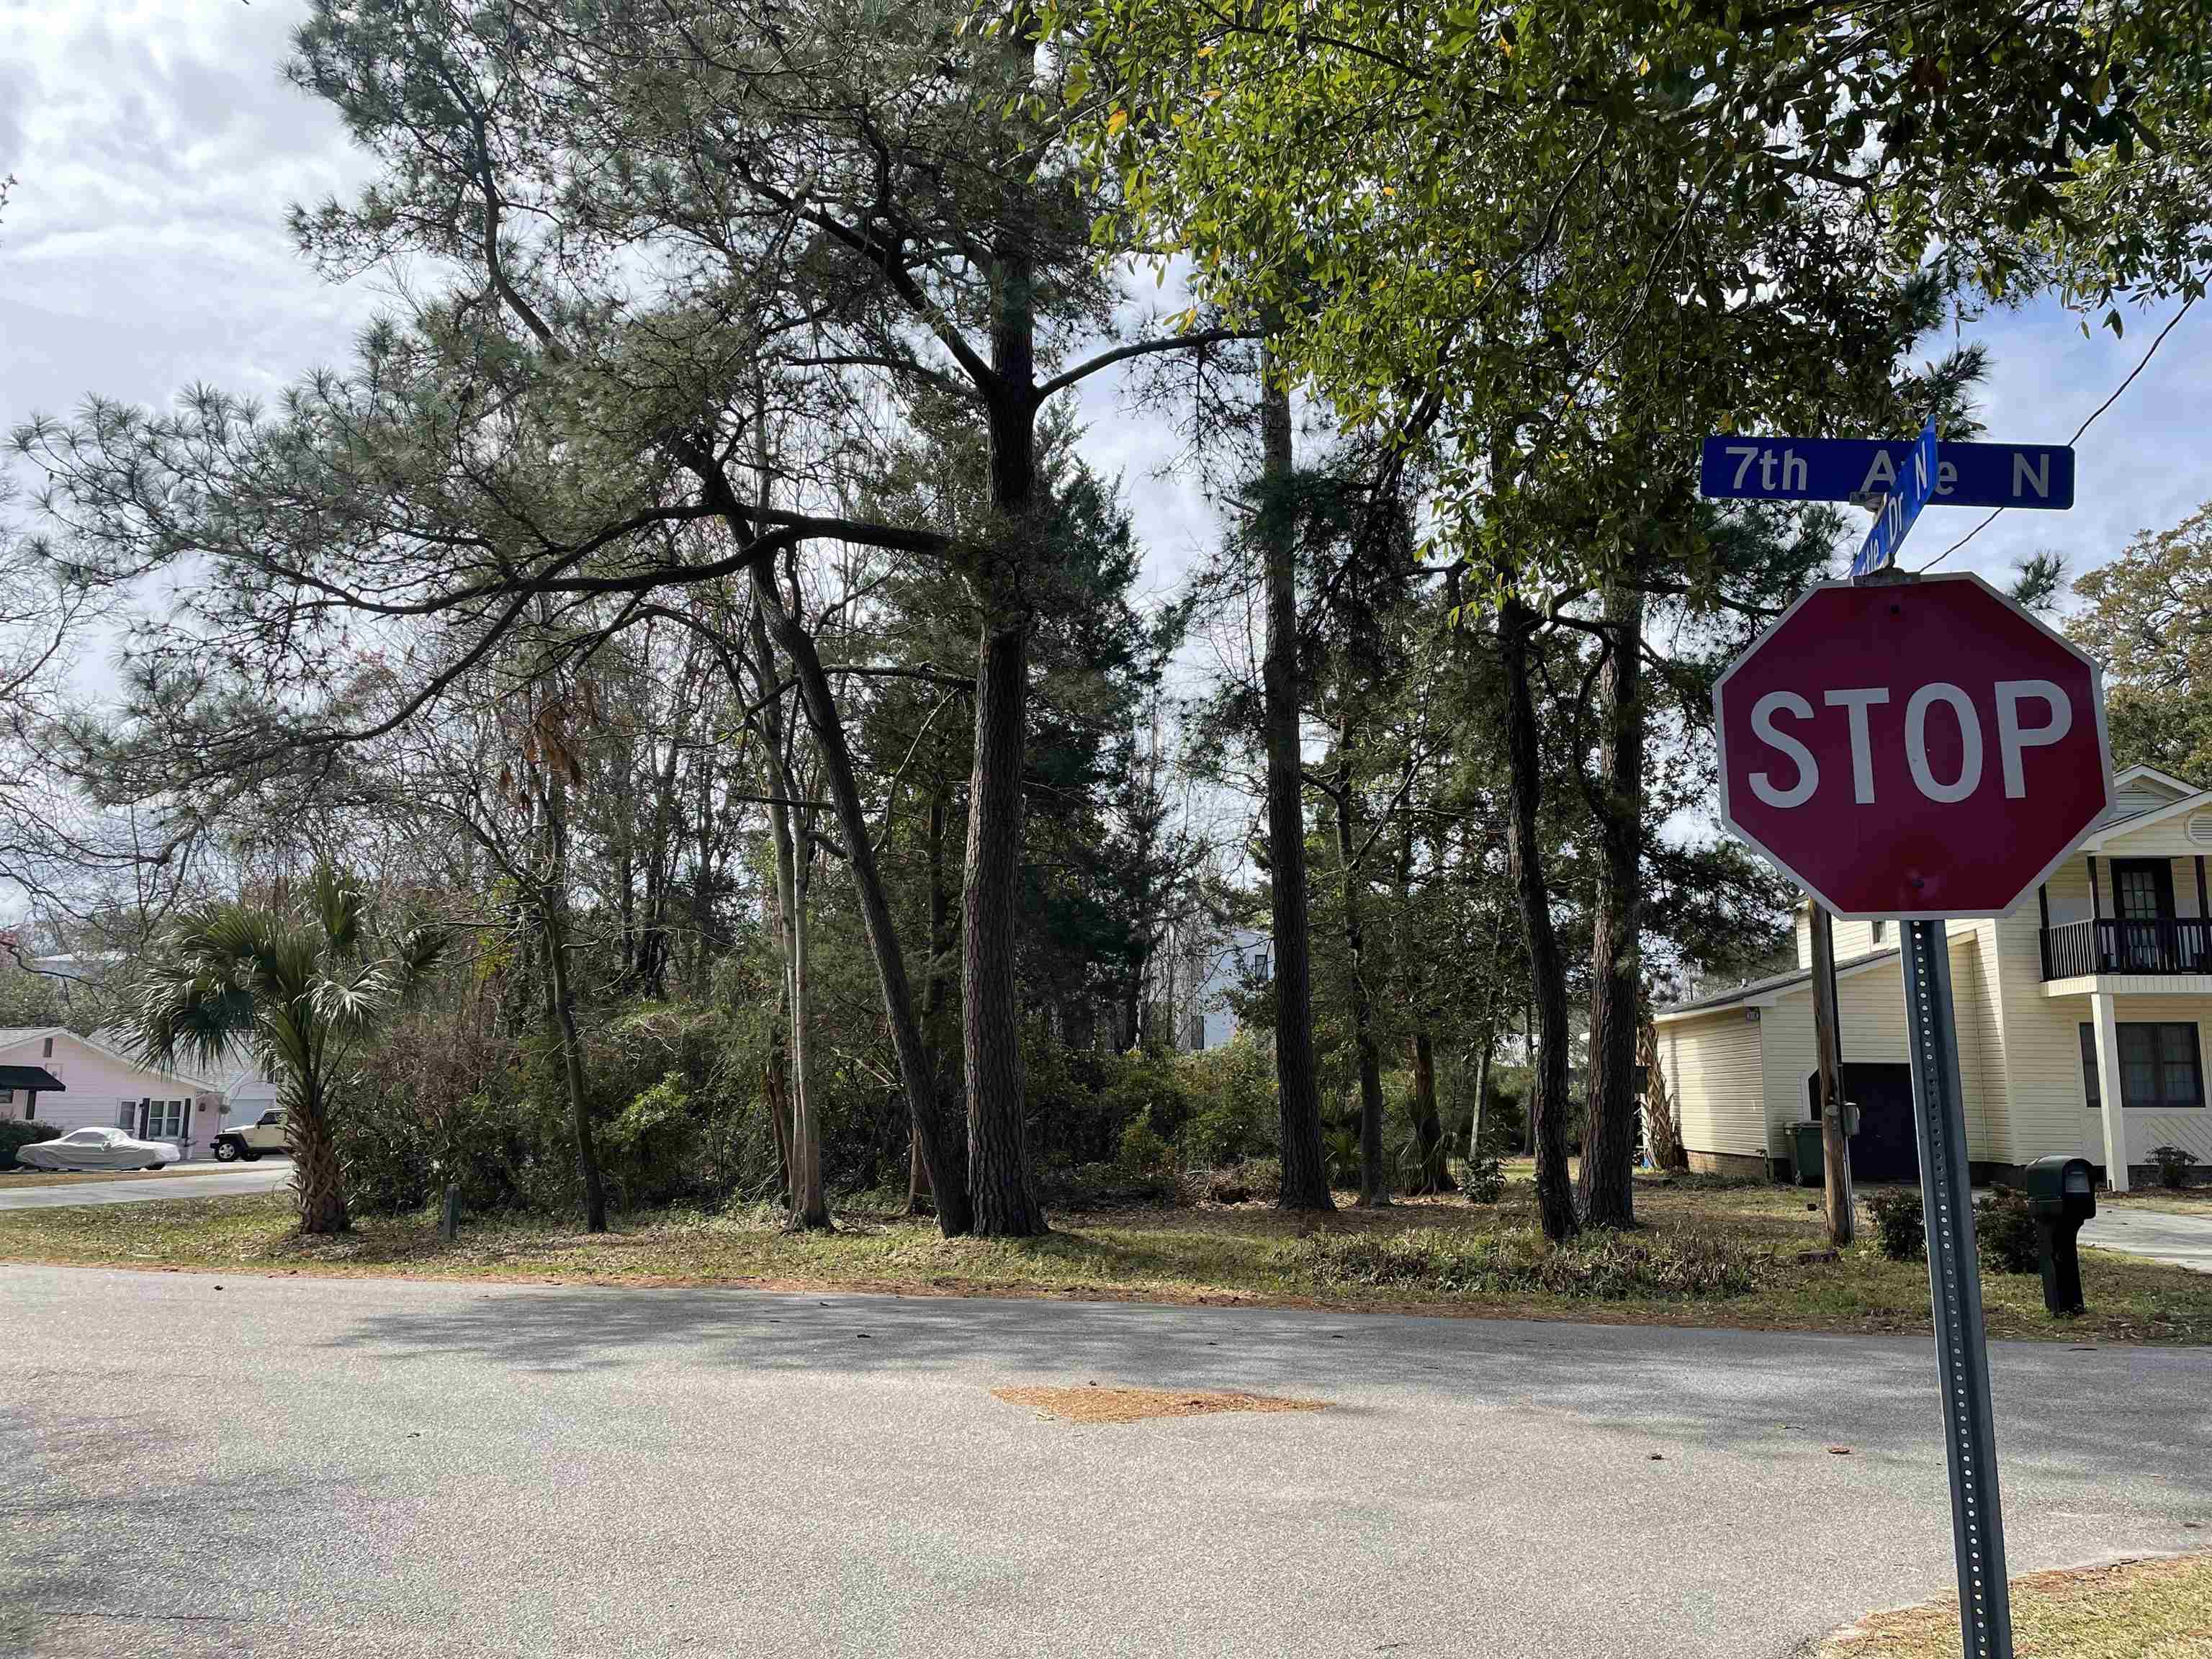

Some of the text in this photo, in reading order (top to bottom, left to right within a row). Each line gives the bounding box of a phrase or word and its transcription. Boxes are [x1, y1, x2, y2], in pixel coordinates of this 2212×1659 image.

[1726, 446, 2049, 498] 7th Ae N
[1888, 492, 1903, 549] Dr
[1915, 440, 1927, 502] N
[1748, 679, 2072, 809] STOP
